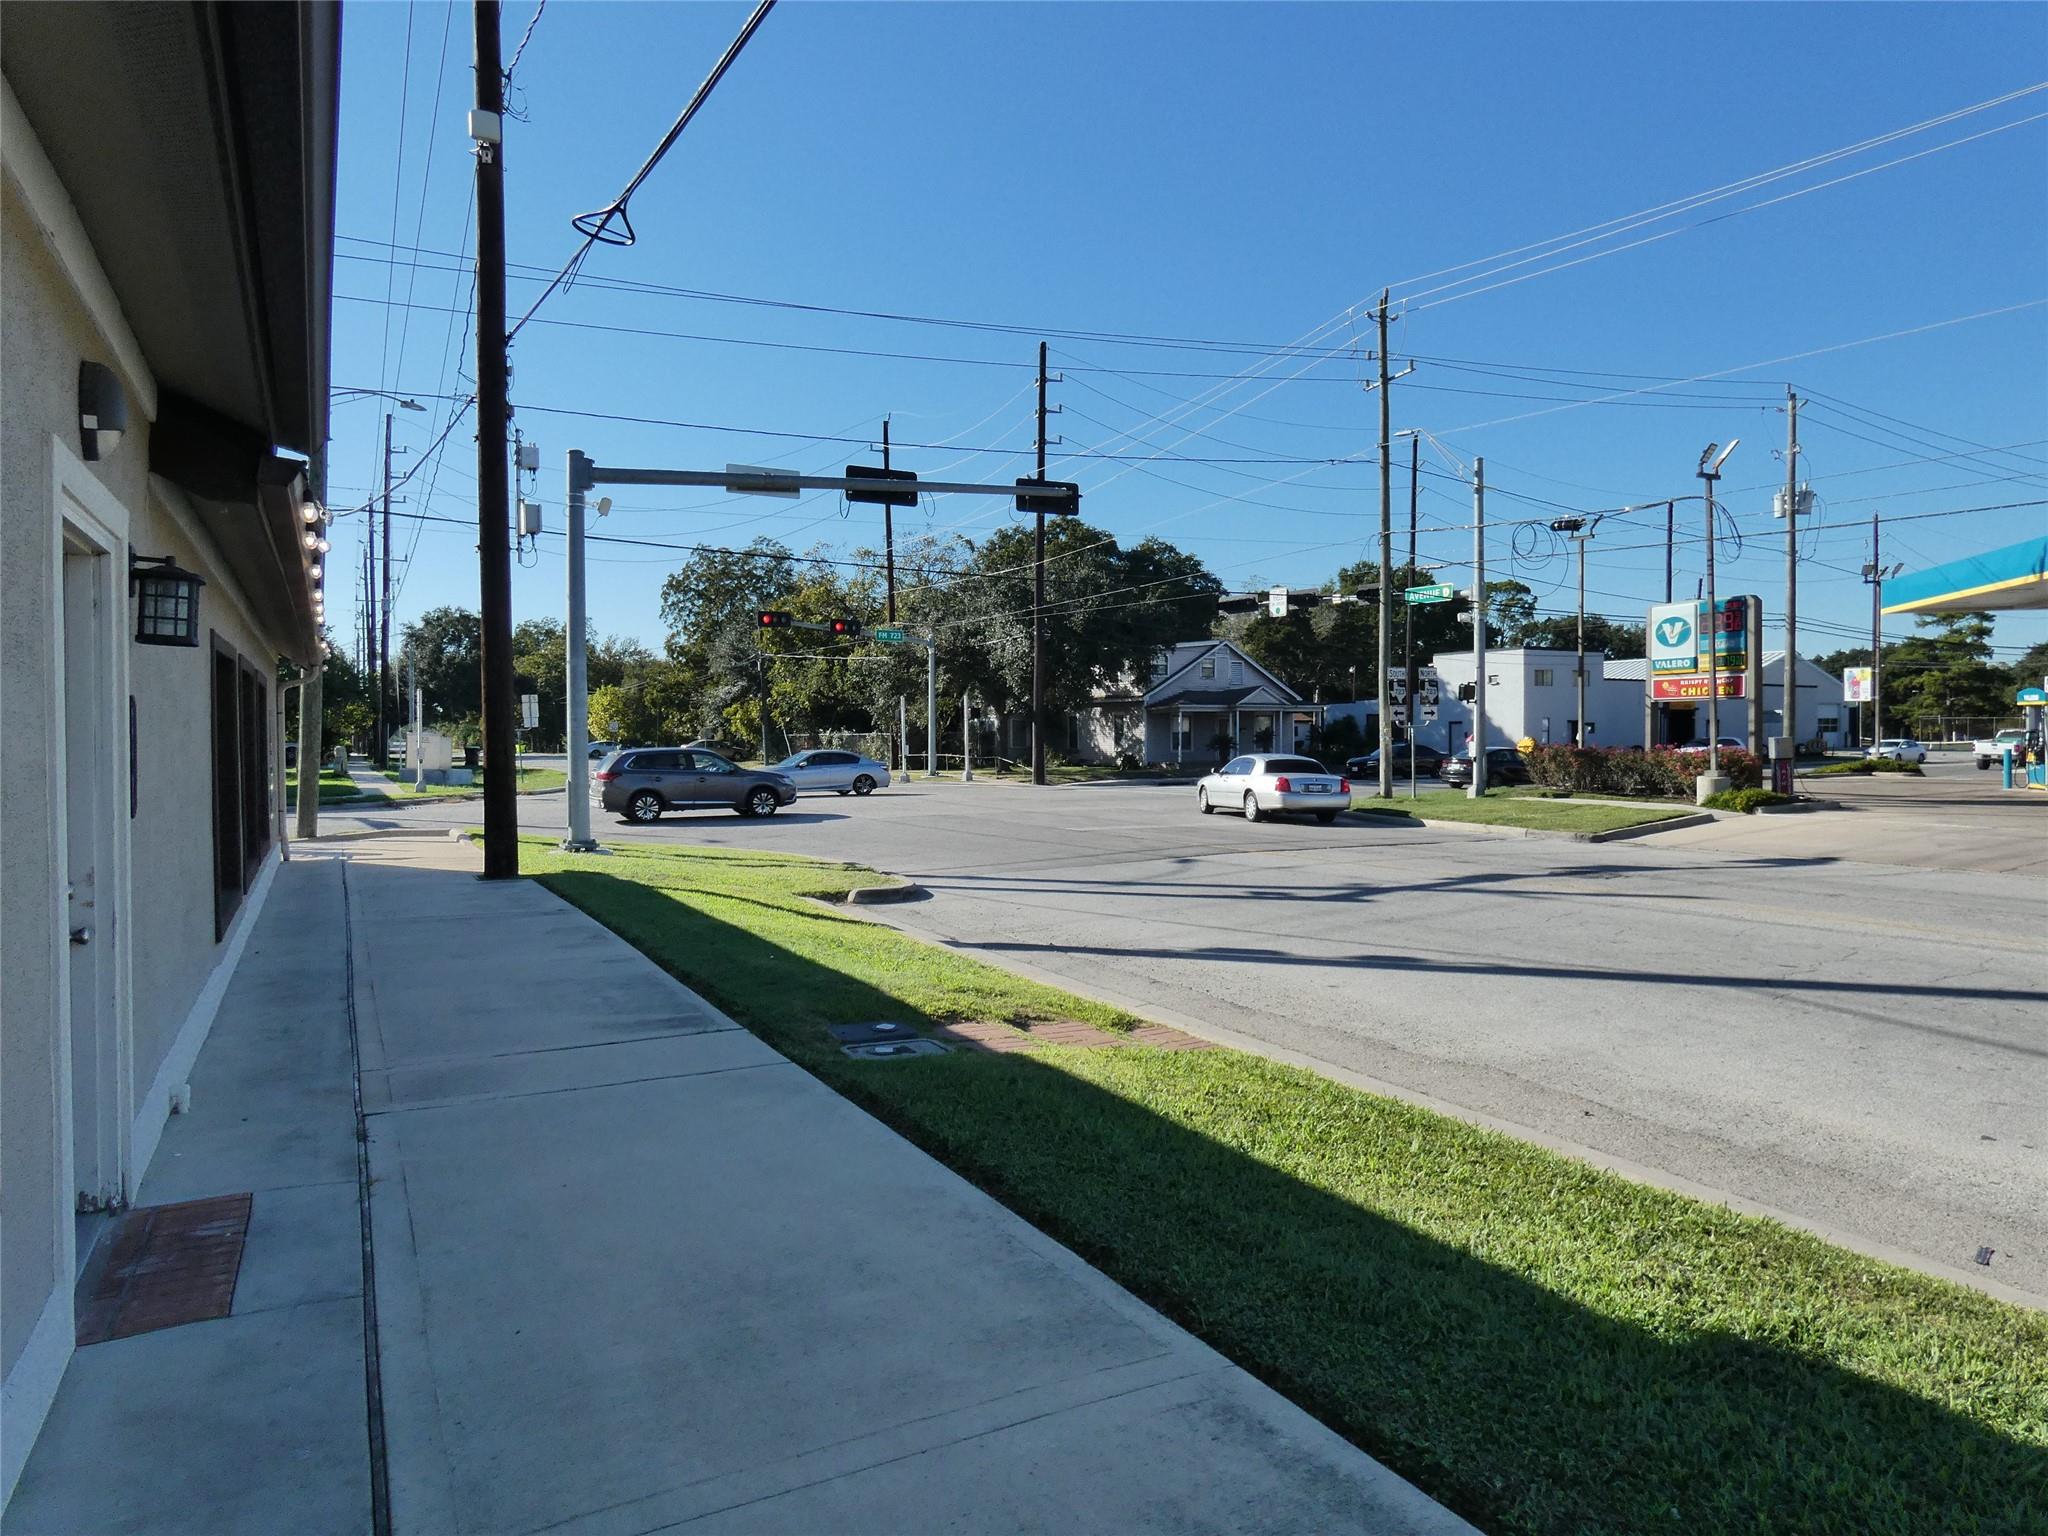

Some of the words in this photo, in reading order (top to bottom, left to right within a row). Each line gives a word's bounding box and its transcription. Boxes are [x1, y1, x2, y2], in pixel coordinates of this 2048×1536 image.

[1409, 588, 1441, 601] AVENUE
[1654, 659, 1690, 669] VALERO
[1389, 669, 1406, 677] SOUTH
[1420, 669, 1437, 677] NORTH
[1680, 685, 1734, 696] CHICEN
